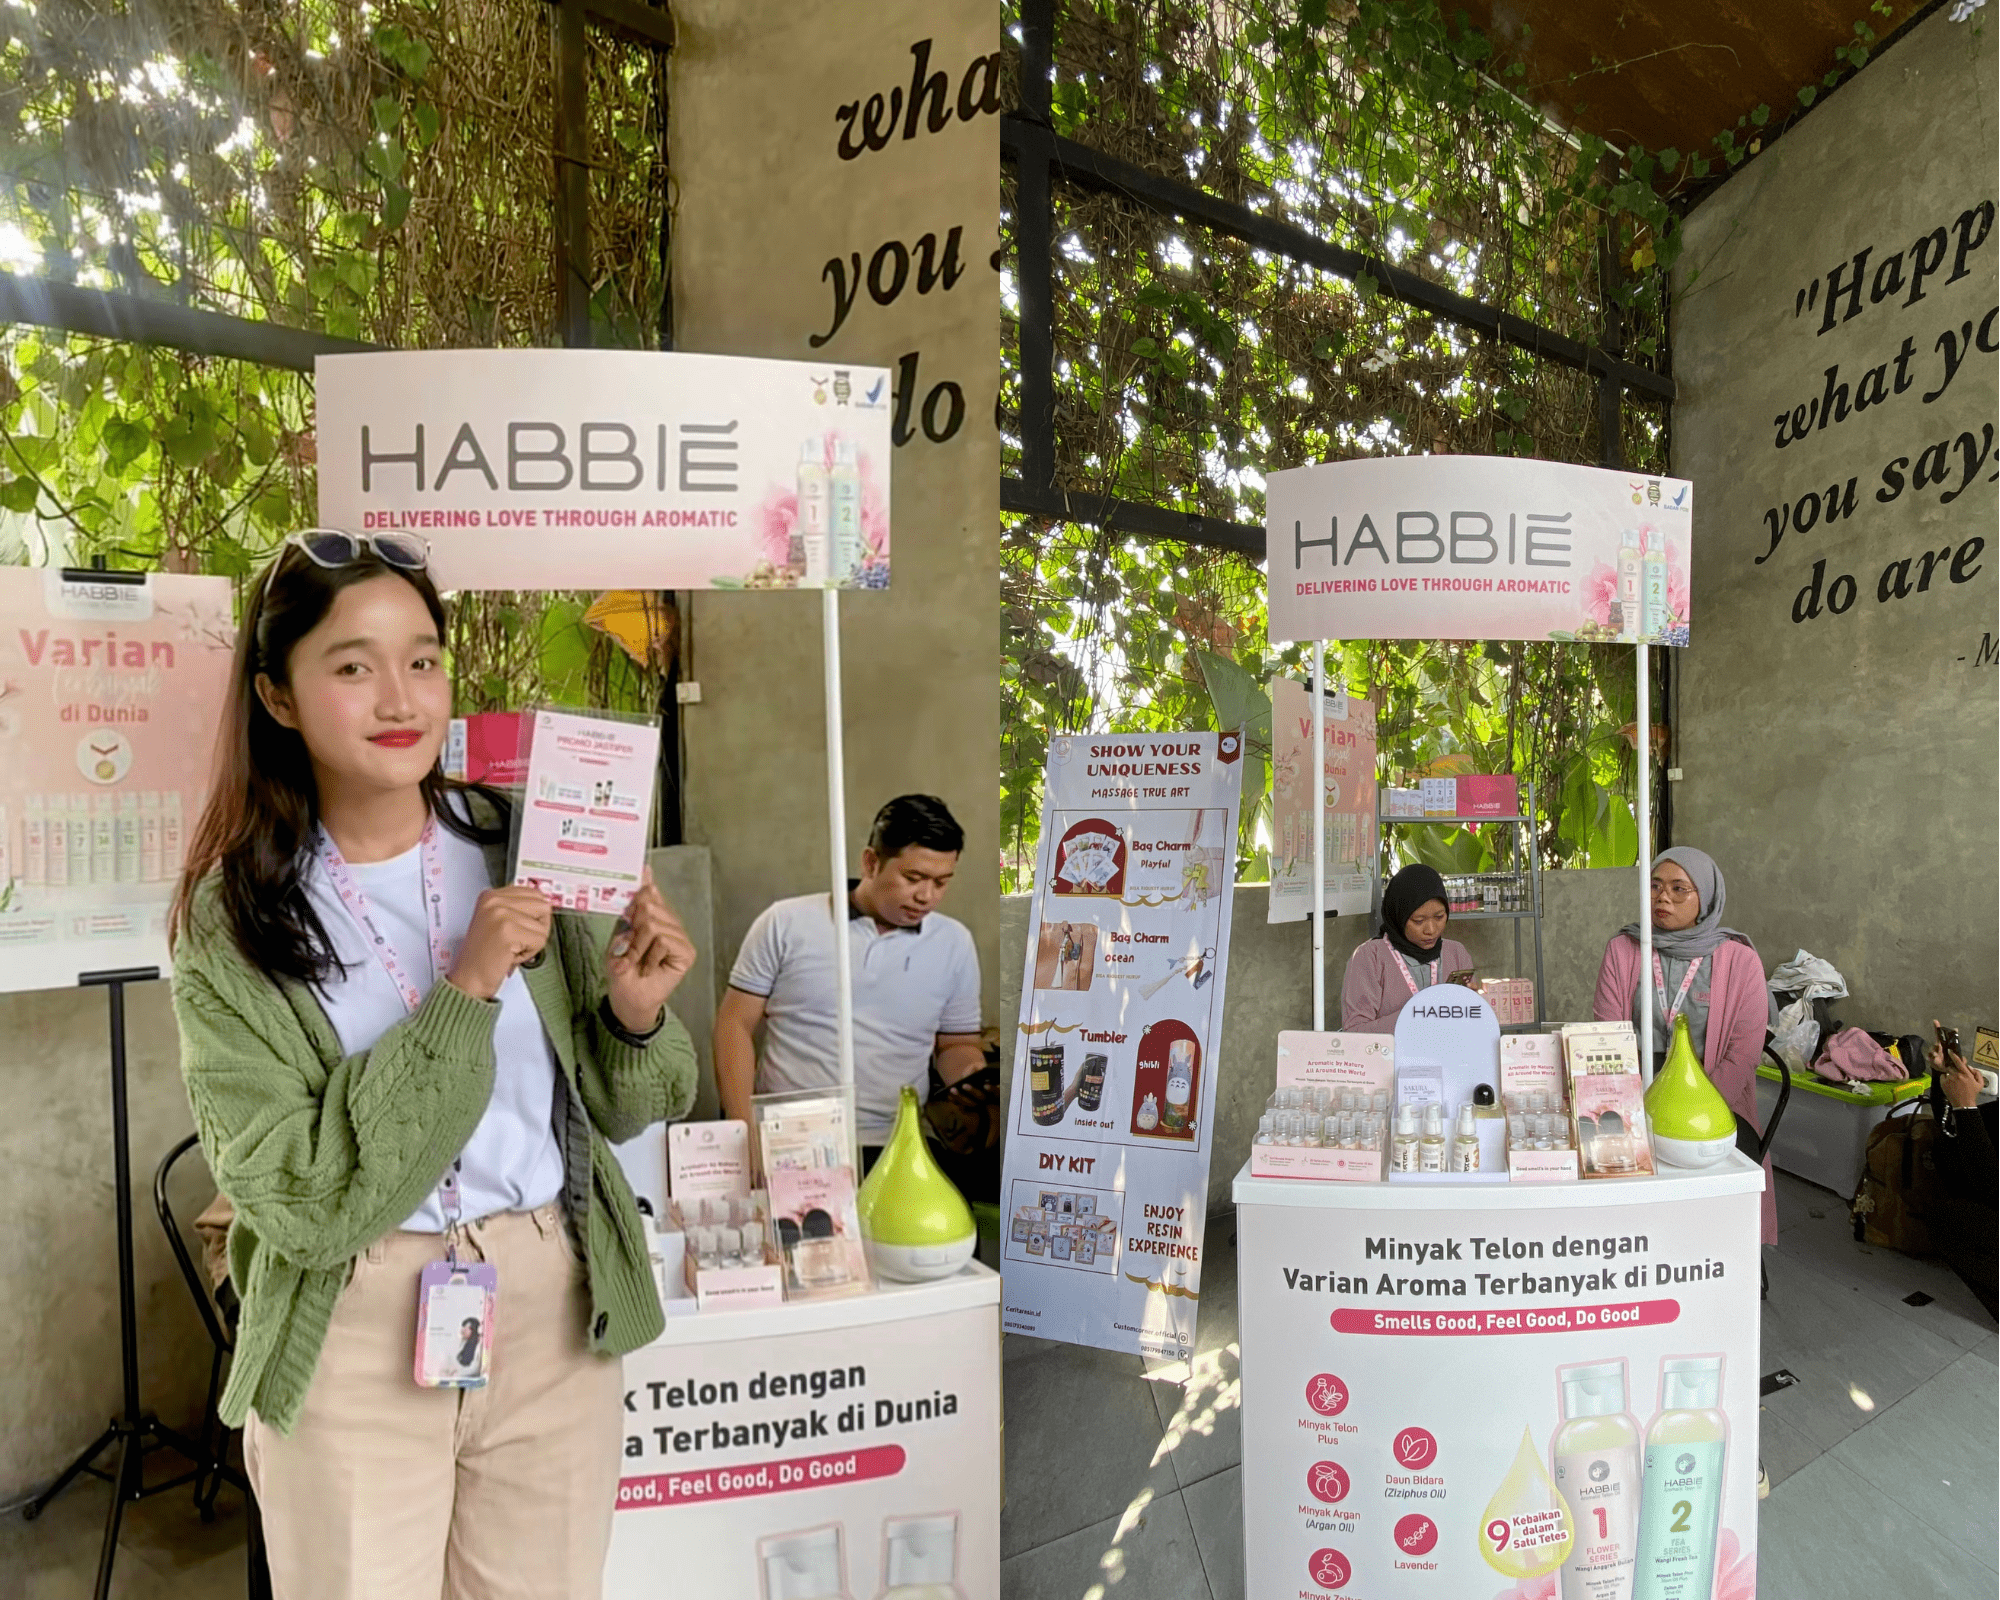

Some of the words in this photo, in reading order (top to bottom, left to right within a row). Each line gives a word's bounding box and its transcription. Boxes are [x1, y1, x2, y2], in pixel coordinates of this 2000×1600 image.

[1796, 200, 1999, 336] "Happ
[809, 225, 966, 348] you
[1775, 336, 1916, 448] what
[364, 510, 480, 528] DELIVERING
[487, 510, 537, 527] LOVE
[542, 510, 636, 527] THROUGH
[642, 510, 738, 527] AROMATIC
[1755, 477, 1859, 564] you
[1296, 577, 1377, 596] DELIVERING
[1381, 577, 1418, 592] LOVE
[1422, 577, 1493, 592] THROUGH
[1497, 579, 1571, 594] AROMATIC
[1791, 559, 1858, 623] do
[1877, 536, 1985, 603] are
[19, 629, 175, 669] Varian
[60, 704, 79, 722] di
[88, 704, 149, 722] Dunia
[1299, 717, 1357, 748] Vrian
[1090, 745, 1145, 758] SHOW
[1150, 743, 1201, 757] YOUR
[1087, 762, 1201, 778] UNIQUENESS
[1091, 787, 1138, 799] MASSAGE
[1143, 787, 1167, 798] TRUE
[1170, 787, 1190, 797] ART
[1132, 841, 1153, 853] Bag
[1155, 840, 1191, 851] Charm
[1140, 859, 1171, 870] Playful
[1110, 932, 1131, 944] Bag
[1134, 932, 1169, 944] Charm
[1079, 1028, 1128, 1044] Tumbler
[1138, 1060, 1160, 1070] ghibli
[1074, 1118, 1097, 1128] inside
[1100, 1119, 1115, 1129] out
[1039, 1152, 1065, 1171] DIY
[1069, 1157, 1096, 1174] KIT
[1143, 1203, 1184, 1221] ENJOY
[1147, 1222, 1183, 1239] RESIN
[1128, 1238, 1199, 1262] EXPERIENCE
[1365, 1237, 1462, 1266] Minyak
[1469, 1237, 1545, 1261] Telon
[1552, 1235, 1649, 1261] dengan
[1282, 1267, 1368, 1294] Varian
[1377, 1273, 1466, 1296] Aroma
[1474, 1268, 1618, 1297] Terbanyak
[1624, 1264, 1648, 1287] di
[1655, 1259, 1725, 1285] Dunia
[1374, 1313, 1431, 1330] Smells
[1435, 1313, 1482, 1332] Good,
[1486, 1311, 1522, 1329] Feel
[1526, 1310, 1572, 1329] Good,
[1576, 1309, 1597, 1325] Do
[1600, 1306, 1640, 1324] Good
[647, 1381, 738, 1410] Telon
[749, 1365, 866, 1400] dengan
[654, 1411, 828, 1455] Terbanyak
[837, 1404, 864, 1433] di
[875, 1391, 957, 1428] Dunia
[1298, 1418, 1331, 1432] Minyak
[1334, 1422, 1358, 1433] Telon
[1317, 1434, 1339, 1445] Plus
[616, 1481, 662, 1503] ood,
[669, 1475, 712, 1498] Feel
[719, 1469, 773, 1491] Good,
[780, 1464, 803, 1484] Do
[810, 1456, 856, 1480] Good
[1386, 1475, 1410, 1485] Daun
[1413, 1475, 1444, 1485] Bidara
[1384, 1488, 1428, 1499] (Ziziphus
[1430, 1488, 1447, 1499] Oil)
[1298, 1505, 1331, 1519] Minyak
[1333, 1509, 1361, 1521] Argan
[1670, 1500, 1692, 1532] 2
[1305, 1519, 1336, 1532] (Argan
[1338, 1522, 1355, 1533] Oil)
[1487, 1519, 1511, 1552] 9
[1513, 1509, 1561, 1527] Kebaikan
[1522, 1522, 1554, 1536] dalam
[1592, 1507, 1608, 1539] 1
[1513, 1535, 1537, 1549] Satu
[1539, 1531, 1568, 1545] Tetes
[1671, 1538, 1685, 1547] TEA
[1586, 1544, 1620, 1555] FLOWER
[1589, 1552, 1619, 1563] SERIES
[1394, 1560, 1438, 1571] Lavender
[1575, 1564, 1593, 1572] Wangi
